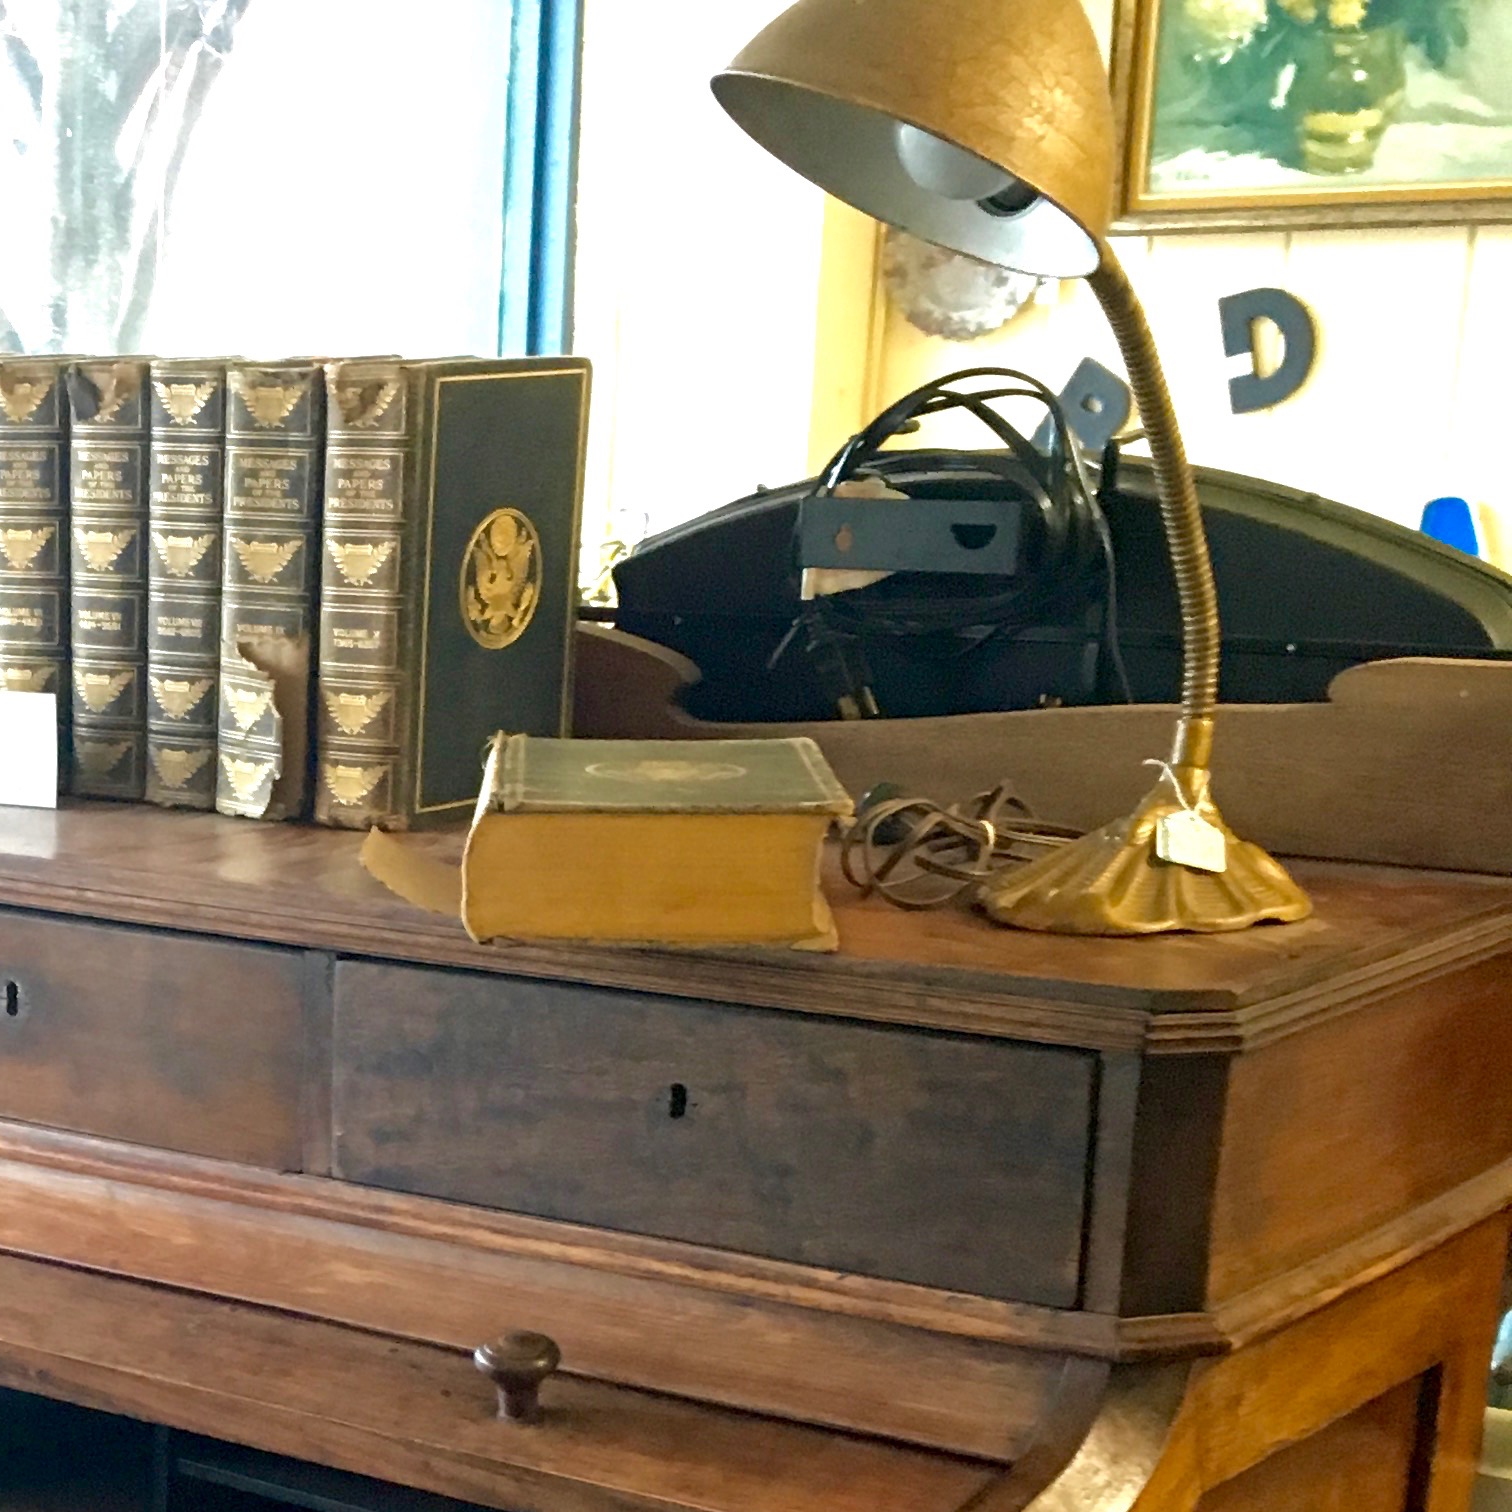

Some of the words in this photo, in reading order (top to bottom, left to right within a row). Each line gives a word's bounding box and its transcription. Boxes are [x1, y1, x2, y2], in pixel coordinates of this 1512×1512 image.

[156, 454, 209, 466] MESSAGES
[239, 457, 297, 470] MESSAGES
[333, 458, 391, 470] MESSAGES
[81, 470, 122, 481] PAPERS
[161, 473, 203, 485] PAPERS
[244, 477, 290, 489] PAPERS
[337, 478, 384, 491] PAPERS
[152, 491, 213, 504] PRESIDENTS
[233, 496, 300, 510] PRESIDENTS
[328, 497, 394, 510] PRESIDENTS
